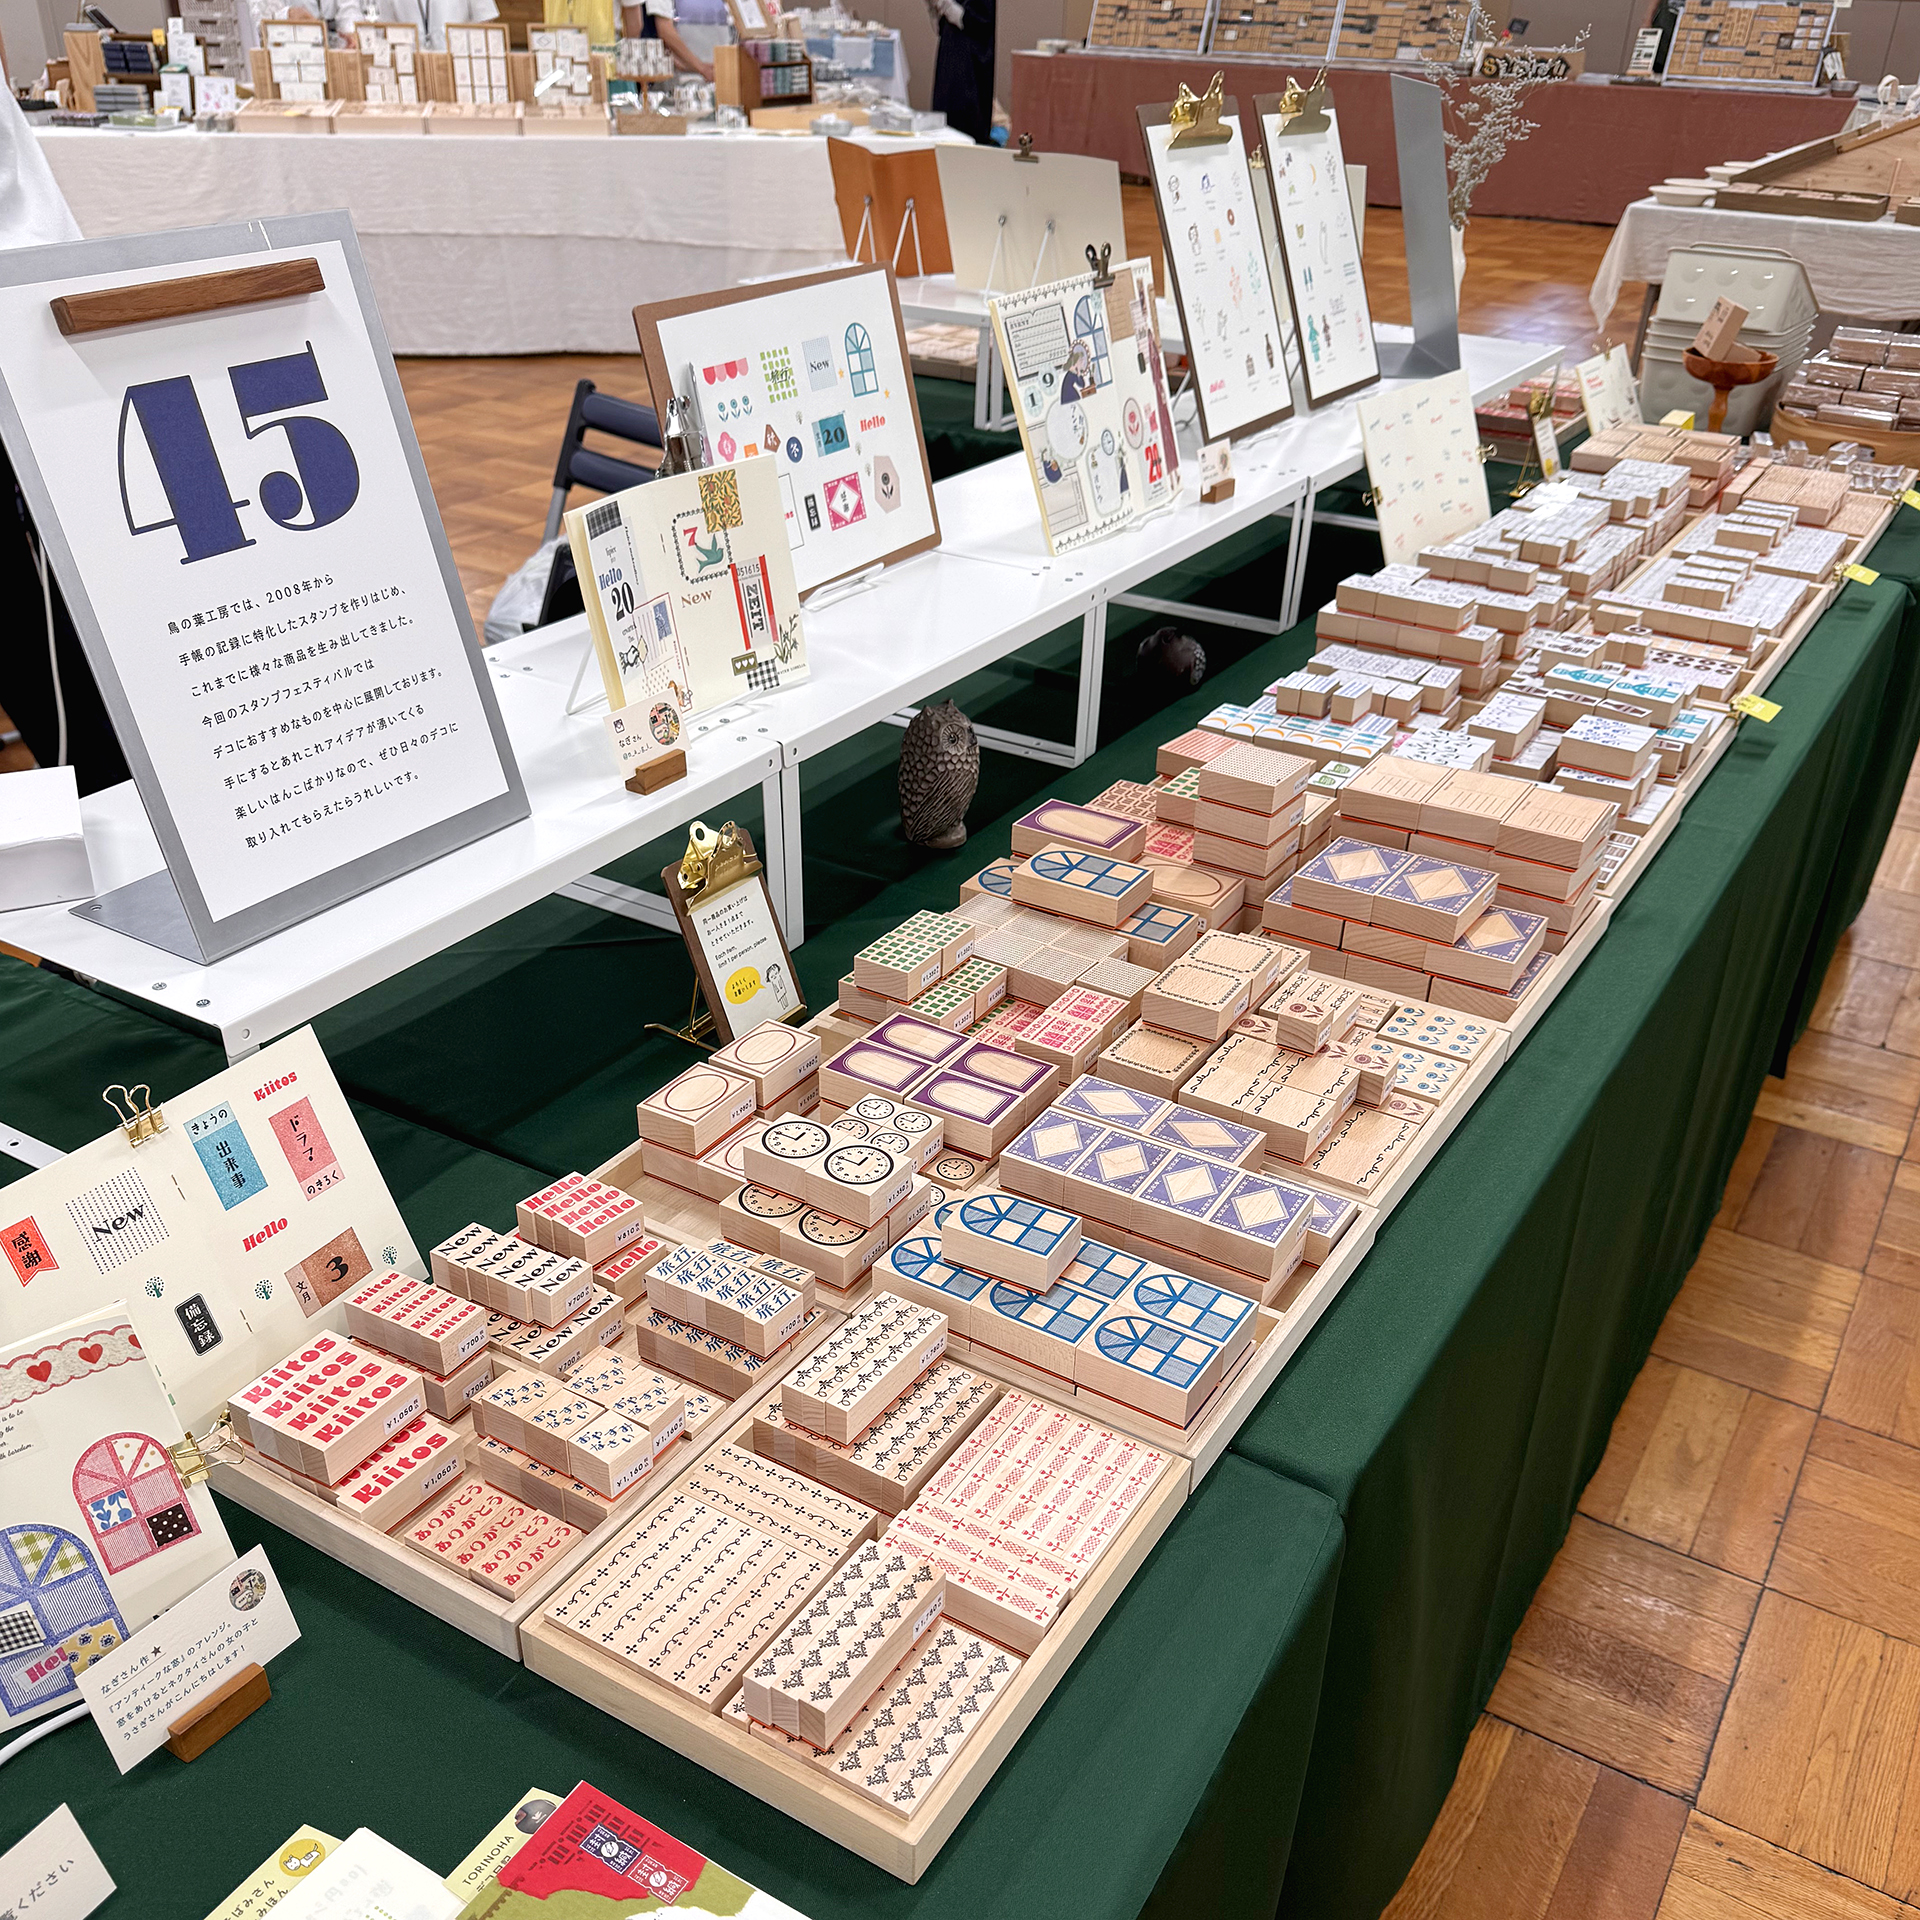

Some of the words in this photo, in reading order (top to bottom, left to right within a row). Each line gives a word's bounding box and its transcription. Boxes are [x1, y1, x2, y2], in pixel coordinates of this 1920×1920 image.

[809, 358, 831, 373] New
[823, 426, 845, 446] 20
[860, 415, 886, 433] Hello
[116, 339, 361, 565] 45
[683, 526, 698, 547] 7
[598, 568, 623, 591] Hello
[611, 582, 635, 622] 20
[680, 590, 713, 609] New
[745, 583, 765, 631] ZEIT
[190, 615, 415, 698] これまでに様々な商品を生み出してきました。
[201, 658, 375, 729] 今回のスタンプフェスティバルでは
[213, 666, 443, 760] デコにおすすめなものを中心に展開しております。
[223, 704, 425, 790] 手にするとあれこれアイデアが湧いてくる
[234, 722, 459, 821] 楽しいはんこばかりなので、ぜひ日々のデコに
[245, 771, 419, 849] 取り入れてもらえたらうれしいです。
[252, 1071, 298, 1102] Kiitos
[190, 1108, 229, 1136] きょうの
[288, 1114, 316, 1163] ドラマ
[215, 1140, 247, 1190] 出来事
[306, 1170, 340, 1196] のきろく
[523, 1175, 584, 1211] Hello
[541, 1182, 602, 1219] Hello
[560, 1189, 621, 1226] Hello
[576, 1198, 636, 1235] Hello
[91, 1203, 147, 1243] New
[241, 1217, 289, 1253] Hello
[11, 1231, 44, 1270] 感謝
[438, 1225, 482, 1256] New
[456, 1233, 499, 1266] New
[476, 1240, 520, 1272] New
[707, 1242, 756, 1262] 旅行
[325, 1254, 350, 1283] 3
[495, 1247, 540, 1280] New
[515, 1255, 558, 1288] New
[540, 1260, 584, 1293] New
[604, 1240, 659, 1280] Hello
[656, 1246, 693, 1277] 旅行
[676, 1254, 713, 1285] 旅行
[760, 1258, 808, 1279] 旅行
[294, 1279, 313, 1304] 文月
[353, 1272, 400, 1305] Kiitos
[696, 1261, 732, 1293] 旅行
[716, 1269, 752, 1301] 旅行
[736, 1277, 772, 1310] 旅行
[371, 1280, 419, 1314] Kiitos
[391, 1288, 438, 1322] Kiitos
[410, 1296, 458, 1330] Kiitos
[567, 1289, 588, 1308] ¥700
[572, 1293, 616, 1328] New
[755, 1287, 792, 1319] 旅行
[184, 1302, 216, 1347] 備忘録
[429, 1304, 477, 1338] Kiitos
[510, 1323, 544, 1351] Ne
[600, 1324, 618, 1342] ¥700
[780, 1319, 797, 1336] ¥700
[460, 1335, 479, 1353] ¥700
[529, 1326, 574, 1360] New
[241, 1337, 337, 1404] Kiitos
[557, 1355, 575, 1373] ¥700
[570, 1367, 624, 1390] おやすみ
[262, 1351, 358, 1419] Kiitos
[287, 1362, 382, 1431] Kiitos
[465, 1380, 484, 1398] ¥700
[488, 1379, 545, 1402] おやすみ
[503, 1388, 548, 1408] なさい
[585, 1376, 627, 1395] なさい
[613, 1386, 667, 1411] おやすみ
[312, 1373, 408, 1443] Kiitos
[386, 1404, 414, 1429] ¥1,050
[531, 1399, 588, 1424] おやすみ
[546, 1410, 590, 1430] なさい
[627, 1397, 670, 1416] なさい
[576, 1422, 634, 1445] おやすみ
[590, 1433, 636, 1453] なさい
[655, 1422, 679, 1447] ¥1,160
[351, 1433, 448, 1504] Kiitos
[423, 1465, 452, 1490] ¥1,050
[616, 1463, 644, 1487] ¥1,160
[413, 1484, 483, 1542] ありがとう
[434, 1495, 503, 1553] ありがとう
[456, 1506, 525, 1566] ありがとう
[480, 1515, 550, 1574] ありがとう
[502, 1527, 572, 1586] ありがとう
[116, 1617, 259, 1729] 窓をあけるとネクタイさんの女の子と
[462, 1835, 515, 1885] TORINOHA
